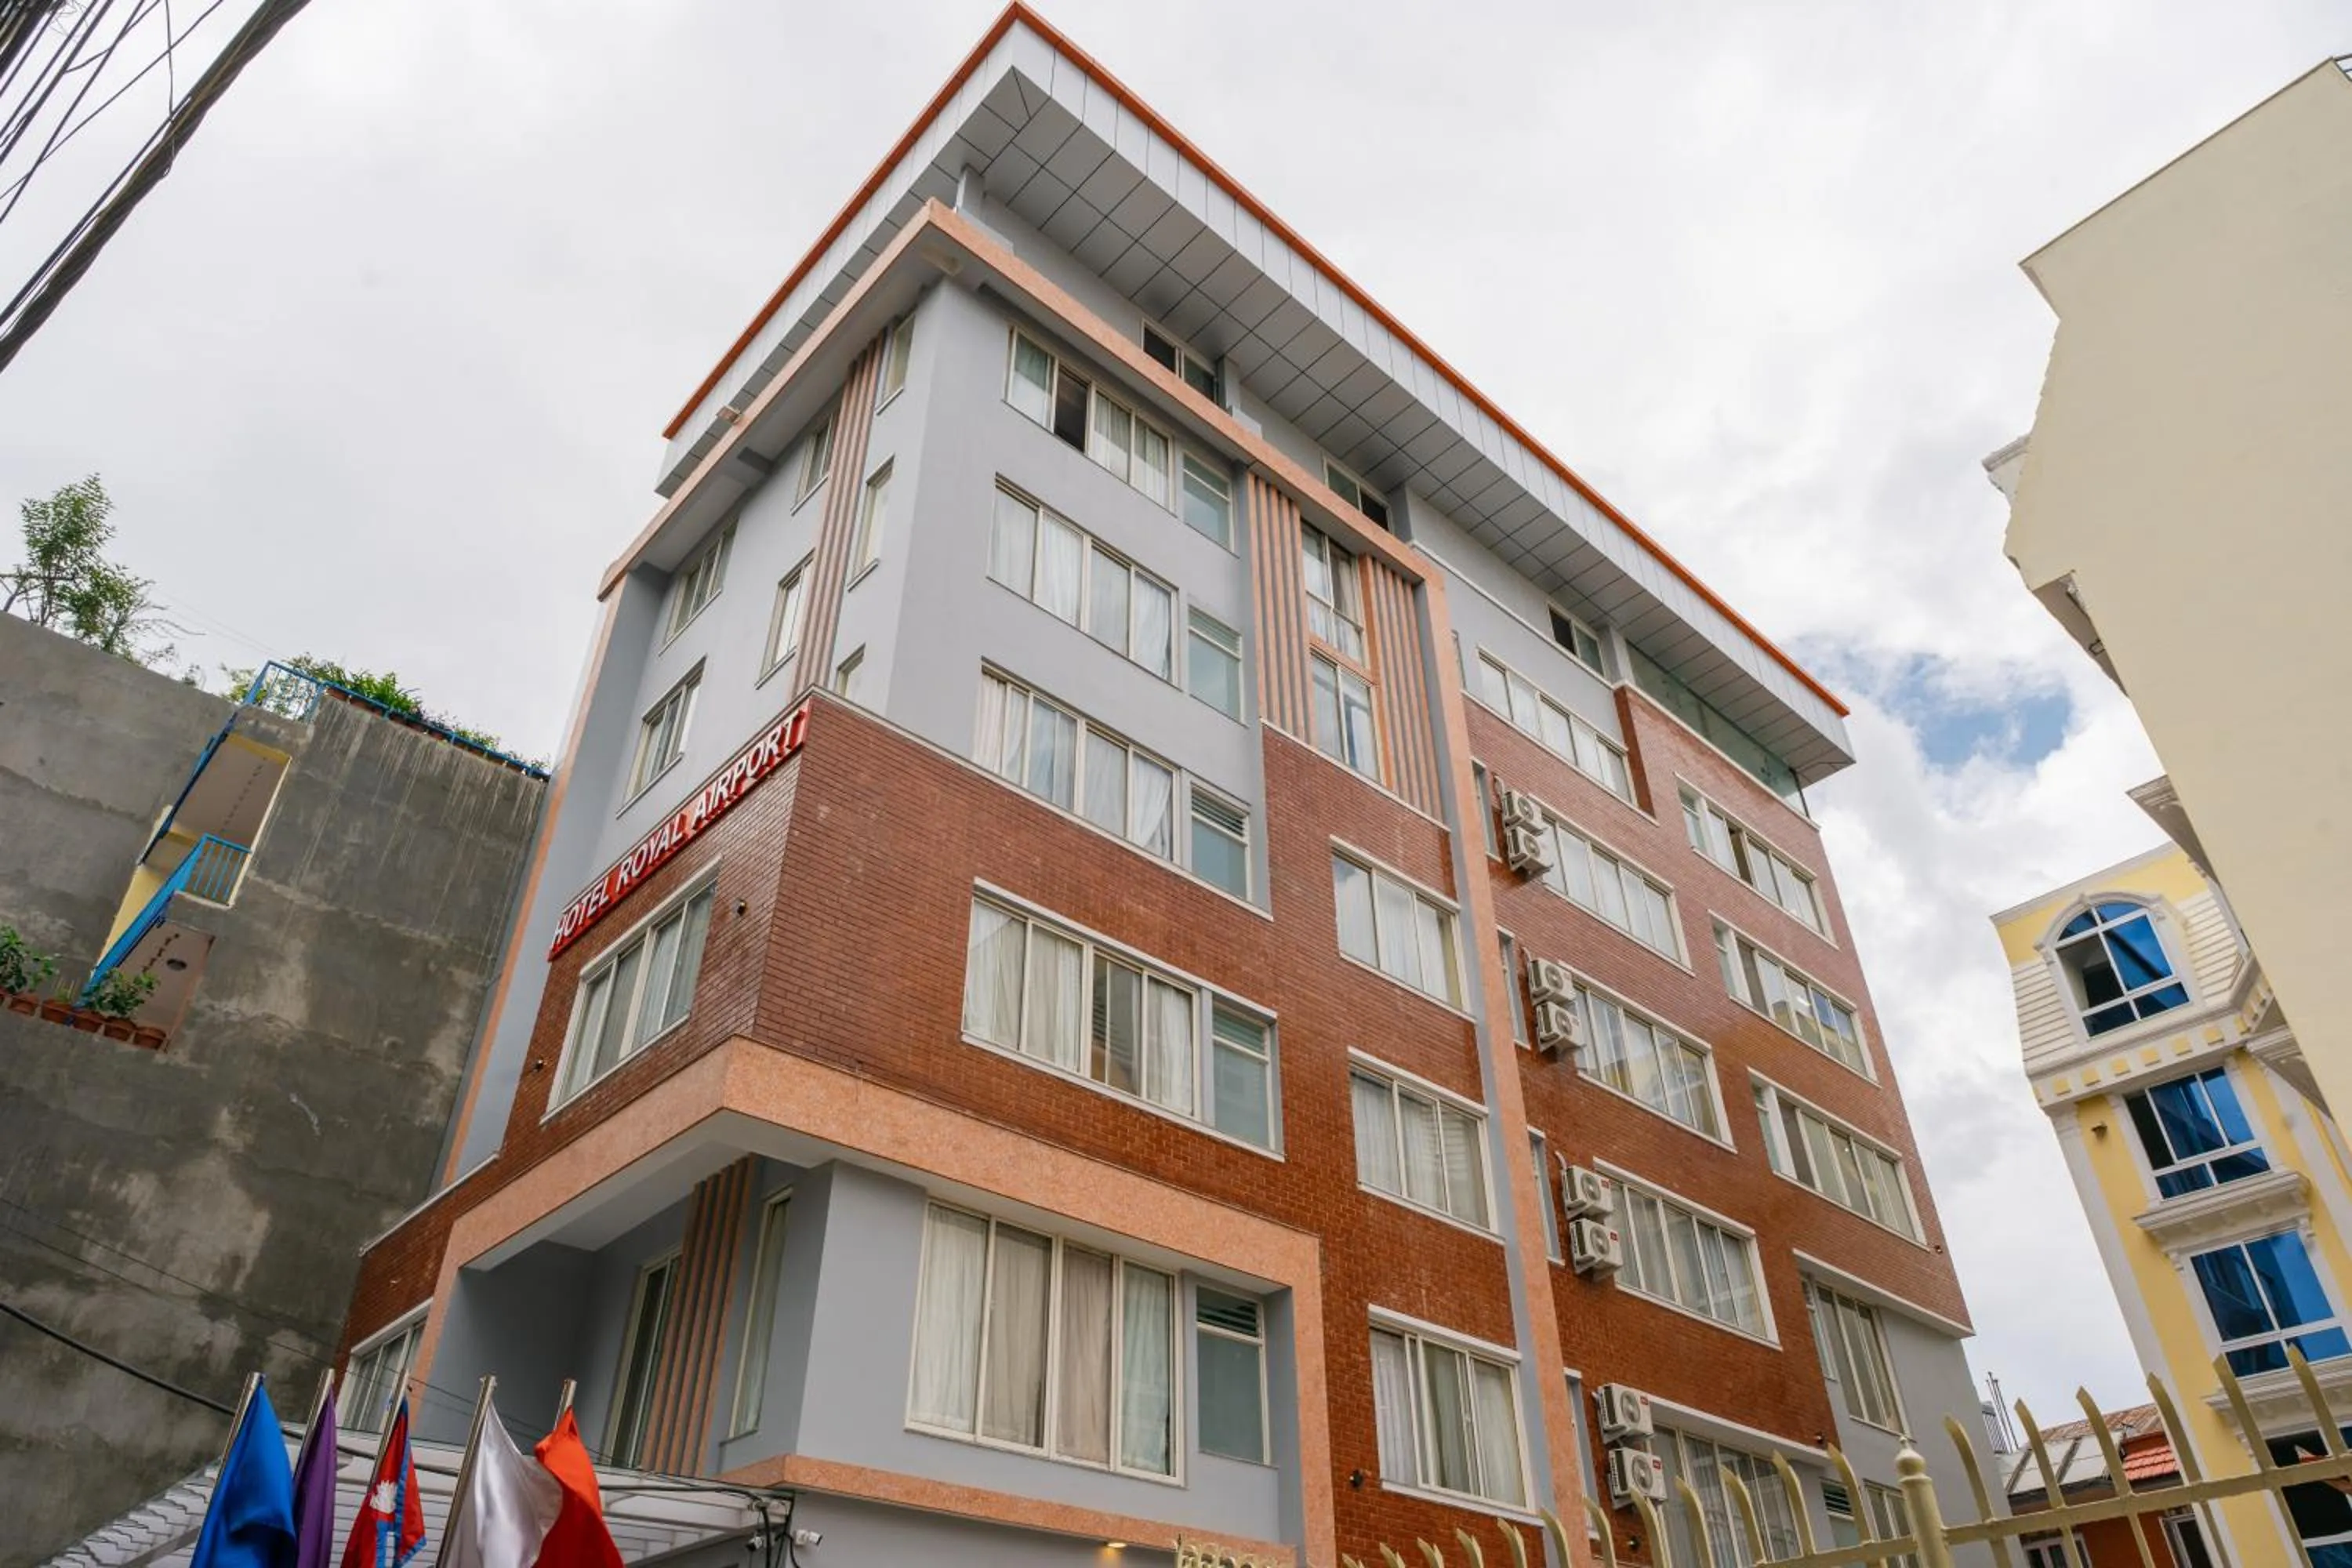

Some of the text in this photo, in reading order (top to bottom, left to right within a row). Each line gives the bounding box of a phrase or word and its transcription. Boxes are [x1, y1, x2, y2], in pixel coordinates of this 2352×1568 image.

[551, 712, 804, 949] HOTEL ROYAL AIRPORT
